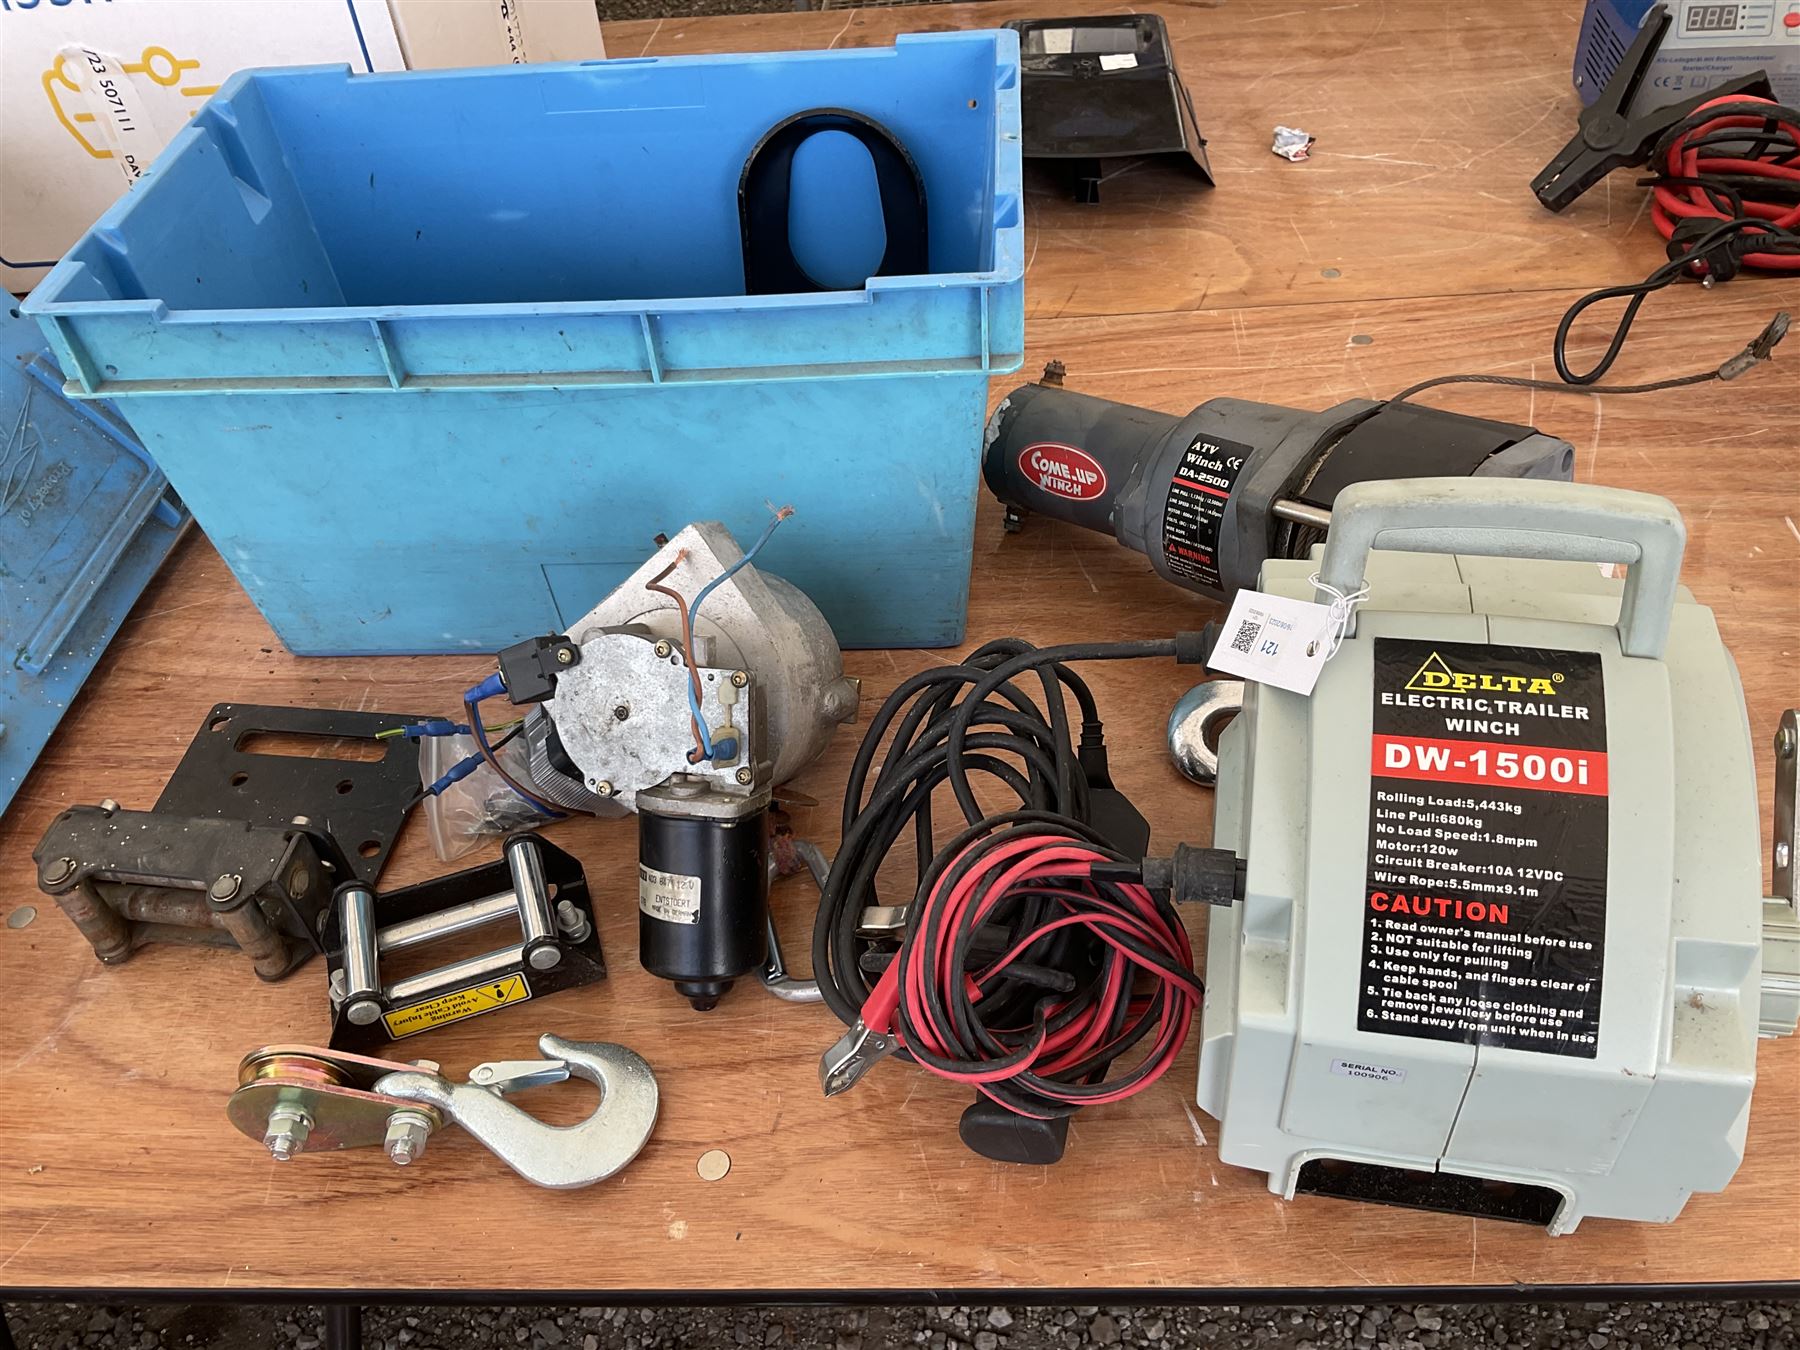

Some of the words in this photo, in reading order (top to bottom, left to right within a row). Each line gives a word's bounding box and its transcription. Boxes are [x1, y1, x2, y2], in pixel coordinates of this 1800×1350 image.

[1192, 441, 1219, 454] ATV
[1186, 452, 1223, 471] Winch
[1179, 467, 1229, 488] DA-2500
[1178, 546, 1210, 564] WARNING
[1260, 640, 1279, 656] 121
[1381, 693, 1488, 712] ELECTRIC
[1494, 700, 1589, 720] TRAILER
[1446, 718, 1519, 736] WINCH
[1385, 743, 1588, 785] DW-1500i
[1377, 791, 1424, 806] Rolling
[1428, 796, 1522, 814] Load:5,443kg
[1376, 809, 1405, 819] Line
[1409, 811, 1482, 828] Pull:680kg
[1376, 824, 1394, 835] No
[1399, 826, 1431, 837] Load
[1435, 829, 1538, 848] Speed:1.8mpm
[1376, 840, 1458, 856] Motor:120w
[1375, 855, 1423, 869] Circuit
[1426, 860, 1513, 877] Breaker:10A
[1518, 868, 1564, 882] 12VDC
[1374, 872, 1406, 884] Wire
[1410, 875, 1539, 897] Rope:5.5mmx9.1m
[1371, 893, 1510, 924] CAUTION
[1371, 919, 1382, 928] 1.
[1385, 920, 1417, 931] Read
[1420, 924, 1471, 937] owner's
[1474, 930, 1522, 943] manual
[1525, 934, 1566, 948] before
[1570, 941, 1592, 950] use
[1371, 932, 1383, 942] 2.
[1386, 933, 1413, 944] NOT
[1416, 936, 1469, 952] suitable
[1472, 942, 1491, 953] for
[1493, 944, 1533, 959] lifting
[1370, 945, 1382, 955] 3.
[1386, 946, 1410, 957] Use
[1413, 949, 1440, 963] only
[1443, 952, 1461, 964] for
[1464, 954, 1509, 970] pulling
[1369, 960, 1381, 970] 4.
[1384, 961, 1416, 976] Keep
[1419, 965, 1462, 980] hands,
[1465, 970, 1489, 981] and
[1492, 972, 1538, 987] fingers
[1541, 979, 1574, 991] clear
[1577, 983, 1590, 992] of
[1384, 974, 1419, 984] cable
[1423, 978, 1457, 990] spool
[415, 1001, 440, 1012] Clear
[442, 994, 465, 1004] Keep
[453, 997, 479, 1008] Avoid
[1367, 986, 1379, 995] 5.
[1382, 987, 1402, 998] Tie
[1406, 989, 1436, 1002] back
[1440, 994, 1463, 1006] any
[1465, 996, 1500, 1010] loose
[1504, 1000, 1556, 1018] clothing
[1559, 1007, 1583, 1018] and
[393, 1013, 422, 1026] Injury
[425, 1004, 450, 1016] Cable
[431, 1007, 472, 1022] Warning
[1382, 1000, 1428, 1012] remove
[1430, 1003, 1492, 1020] jewellery
[1495, 1012, 1536, 1026] before
[1540, 1018, 1563, 1027] use
[1366, 1009, 1379, 1019] 6.
[1382, 1011, 1418, 1023] Stand
[1421, 1015, 1454, 1029] away
[1458, 1020, 1488, 1031] from
[1491, 1024, 1516, 1034] unit
[1519, 1027, 1554, 1039] when
[1557, 1030, 1569, 1041] in
[1572, 1034, 1595, 1043] use
[1341, 1062, 1377, 1072] SERIAL
[1349, 1071, 1388, 1080] 100906
